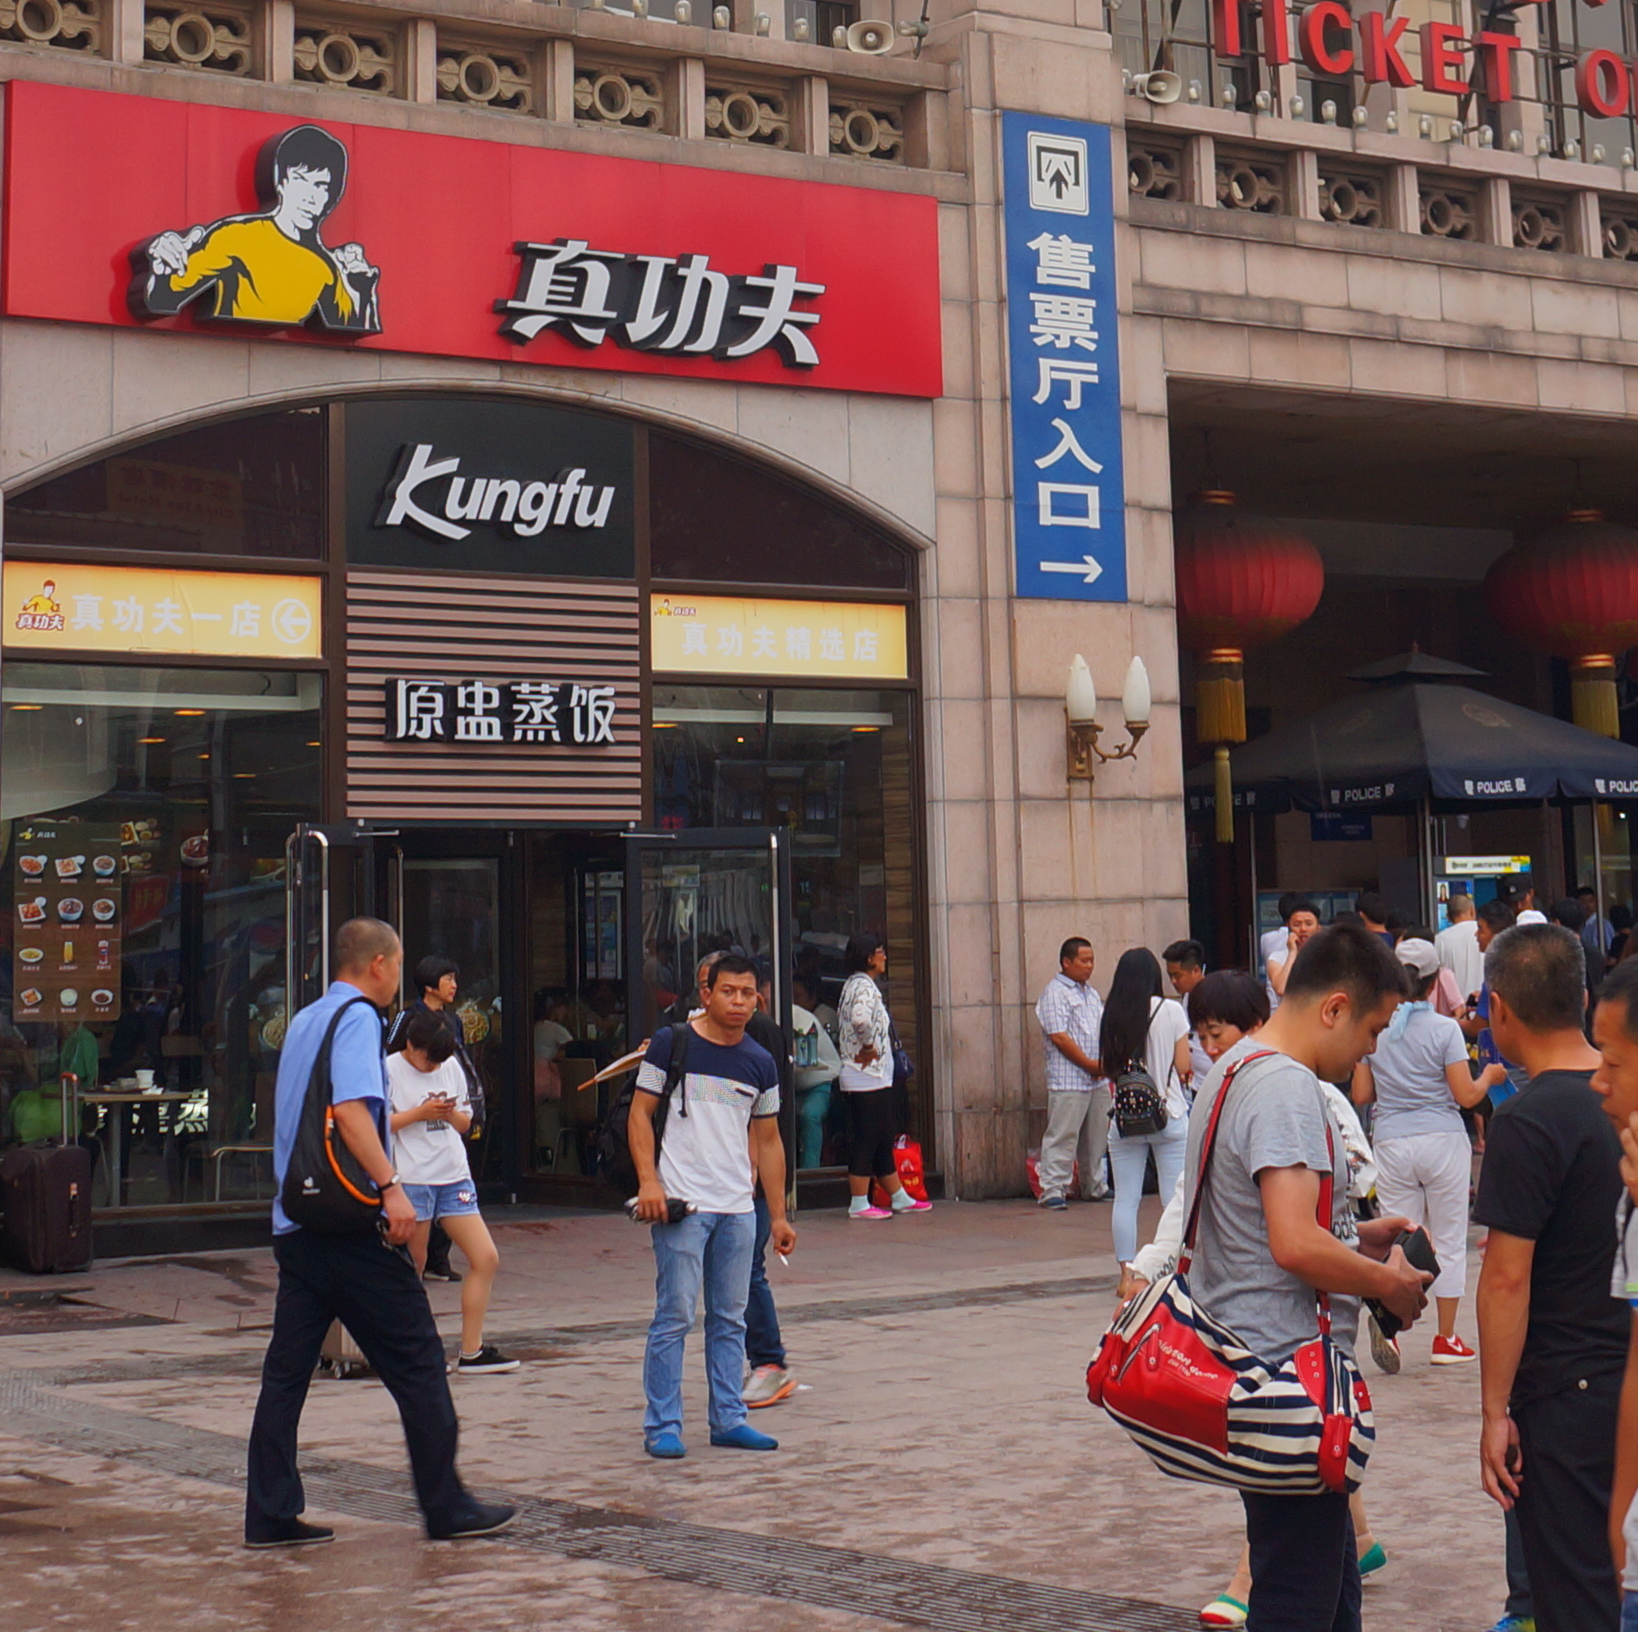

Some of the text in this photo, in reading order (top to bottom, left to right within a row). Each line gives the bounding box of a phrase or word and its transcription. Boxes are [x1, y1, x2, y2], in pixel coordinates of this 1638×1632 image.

[506, 239, 825, 366] 真功夫
[1026, 231, 1103, 529] 售票厅入口
[386, 443, 615, 540] Kungfu
[16, 613, 65, 631] 真功夫
[70, 592, 261, 638] 真功夫一店
[681, 621, 878, 662] 真功夫精选店
[396, 679, 615, 743] 原盅蒸饭
[1344, 786, 1381, 802] POLICE
[1477, 780, 1513, 794] POLICE
